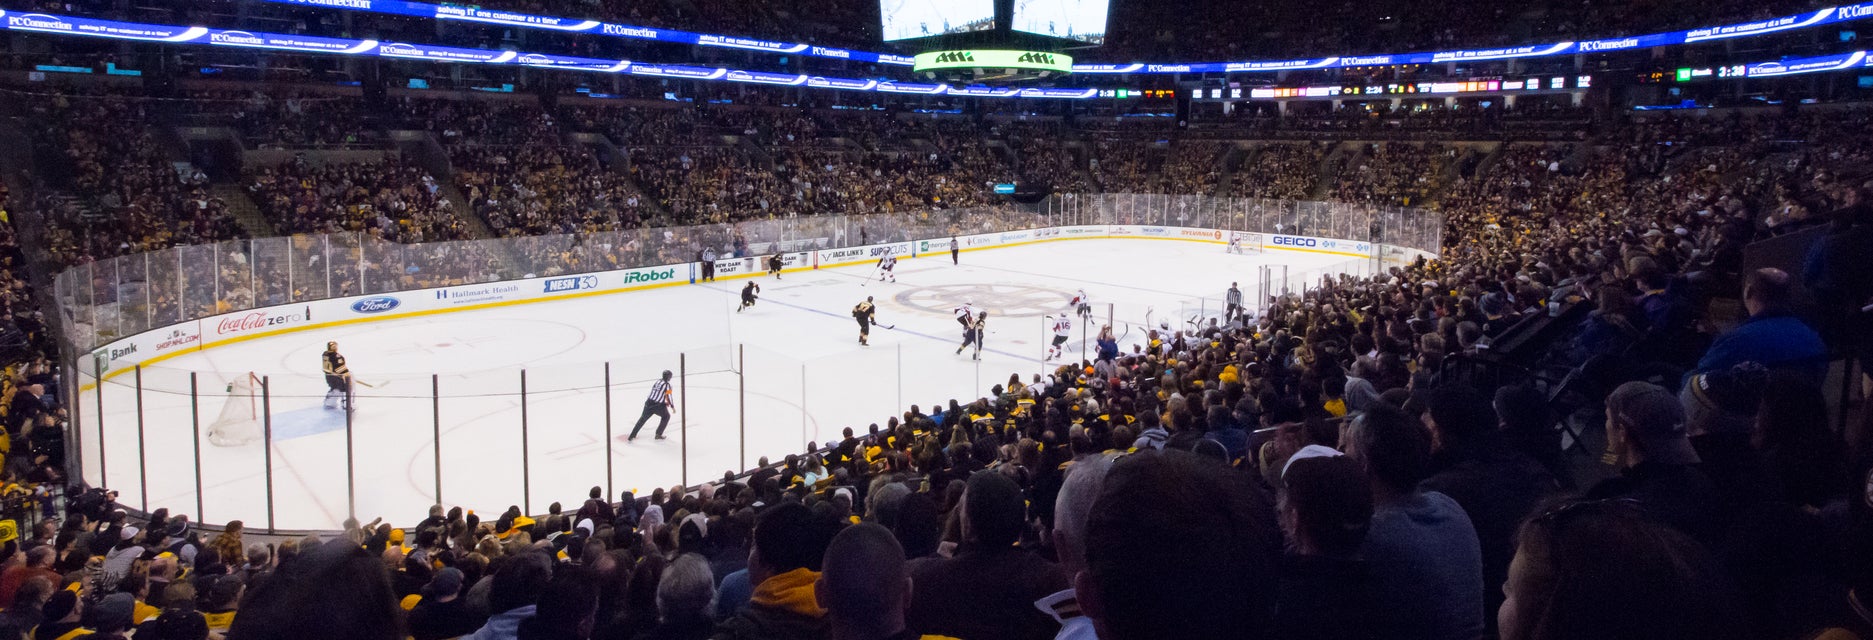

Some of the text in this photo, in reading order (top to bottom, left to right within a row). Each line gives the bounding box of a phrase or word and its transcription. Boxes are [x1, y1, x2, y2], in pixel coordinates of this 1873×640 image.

[437, 6, 466, 16] solving
[466, 8, 476, 16] IT
[492, 12, 526, 21] customer
[1838, 6, 1852, 19] PC
[23, 17, 73, 30] Connection
[603, 23, 657, 39] PC Connection
[1579, 38, 1639, 51] PC Connection
[812, 46, 850, 58] PC Connection
[1341, 56, 1390, 66] PC Connection
[1148, 64, 1190, 72] PC Connection
[1365, 86, 1383, 95] 2:24
[1273, 236, 1317, 248] GEICO
[624, 268, 675, 284] iRobot
[452, 285, 519, 299] Hallmark Health
[360, 300, 391, 311] Ford
[267, 313, 302, 326] zero
[1061, 321, 1071, 330] 16
[111, 343, 138, 361] Bank
